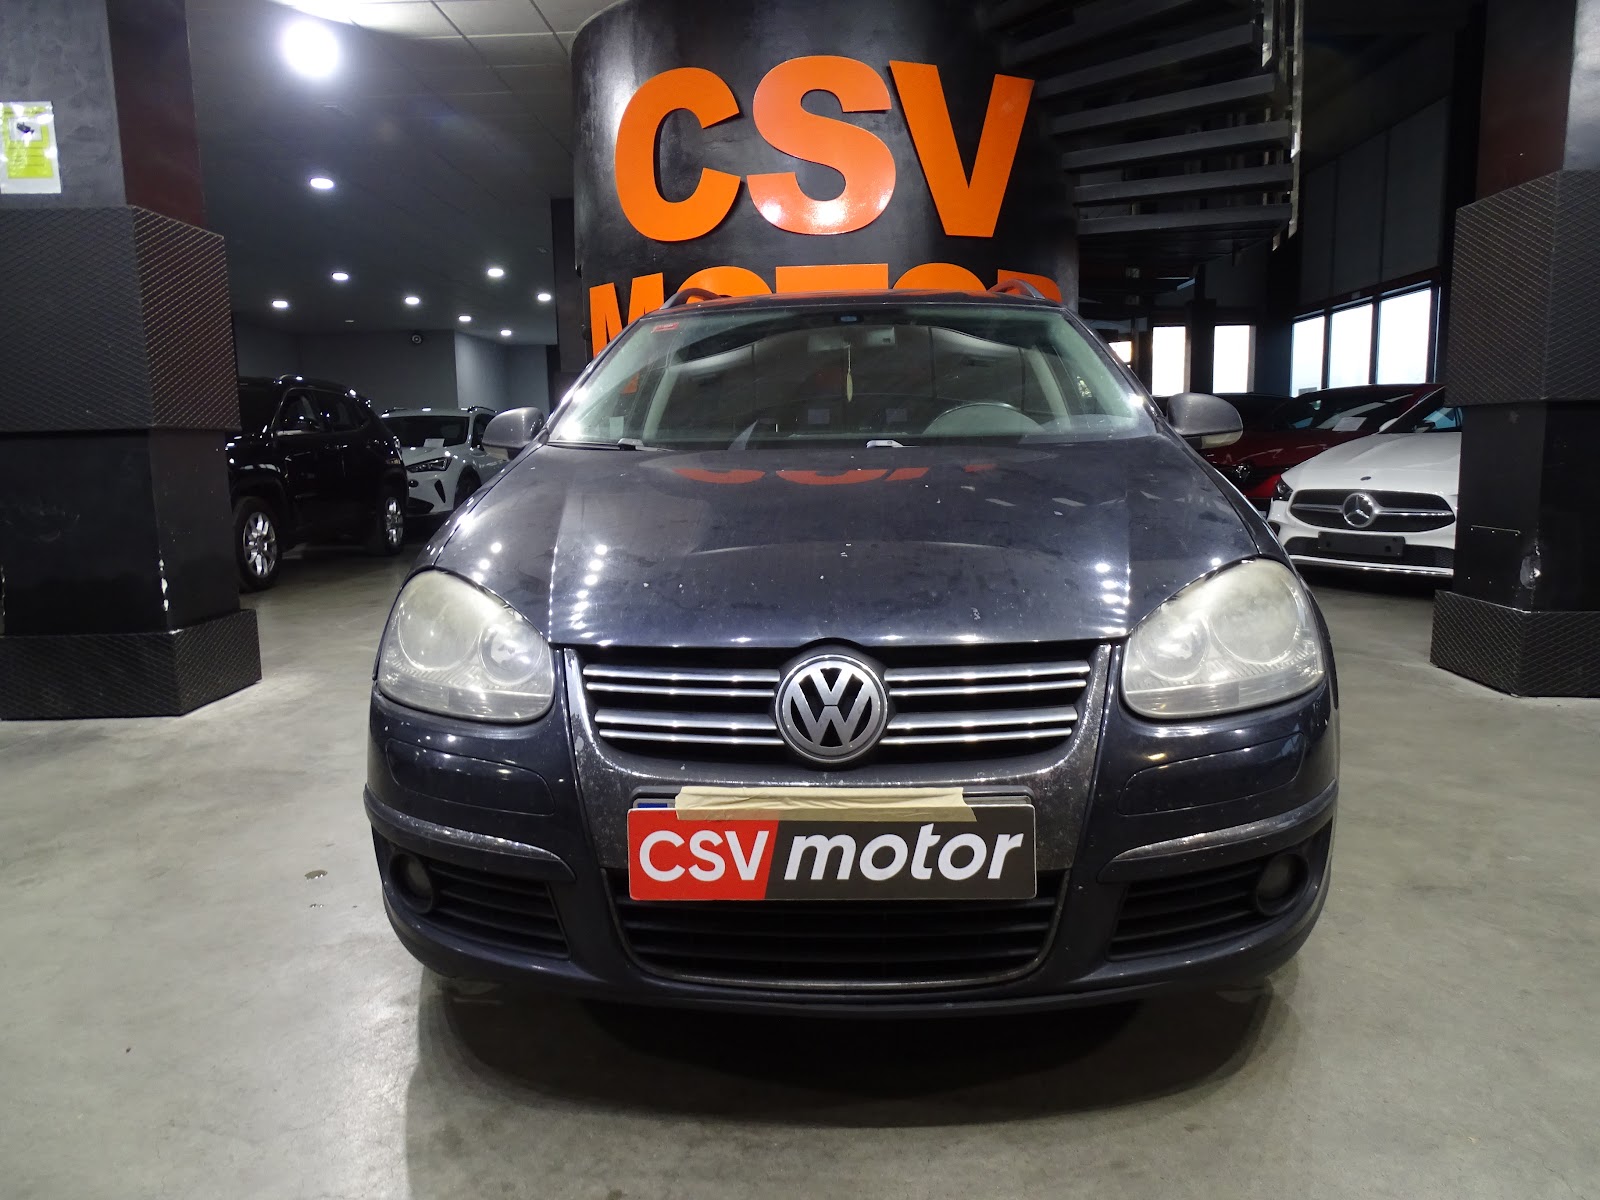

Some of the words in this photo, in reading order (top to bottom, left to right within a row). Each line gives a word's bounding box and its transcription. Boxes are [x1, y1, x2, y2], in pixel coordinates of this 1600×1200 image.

[614, 54, 1035, 243] CSV
[639, 830, 769, 882] CSV
[784, 823, 1024, 881] motor
